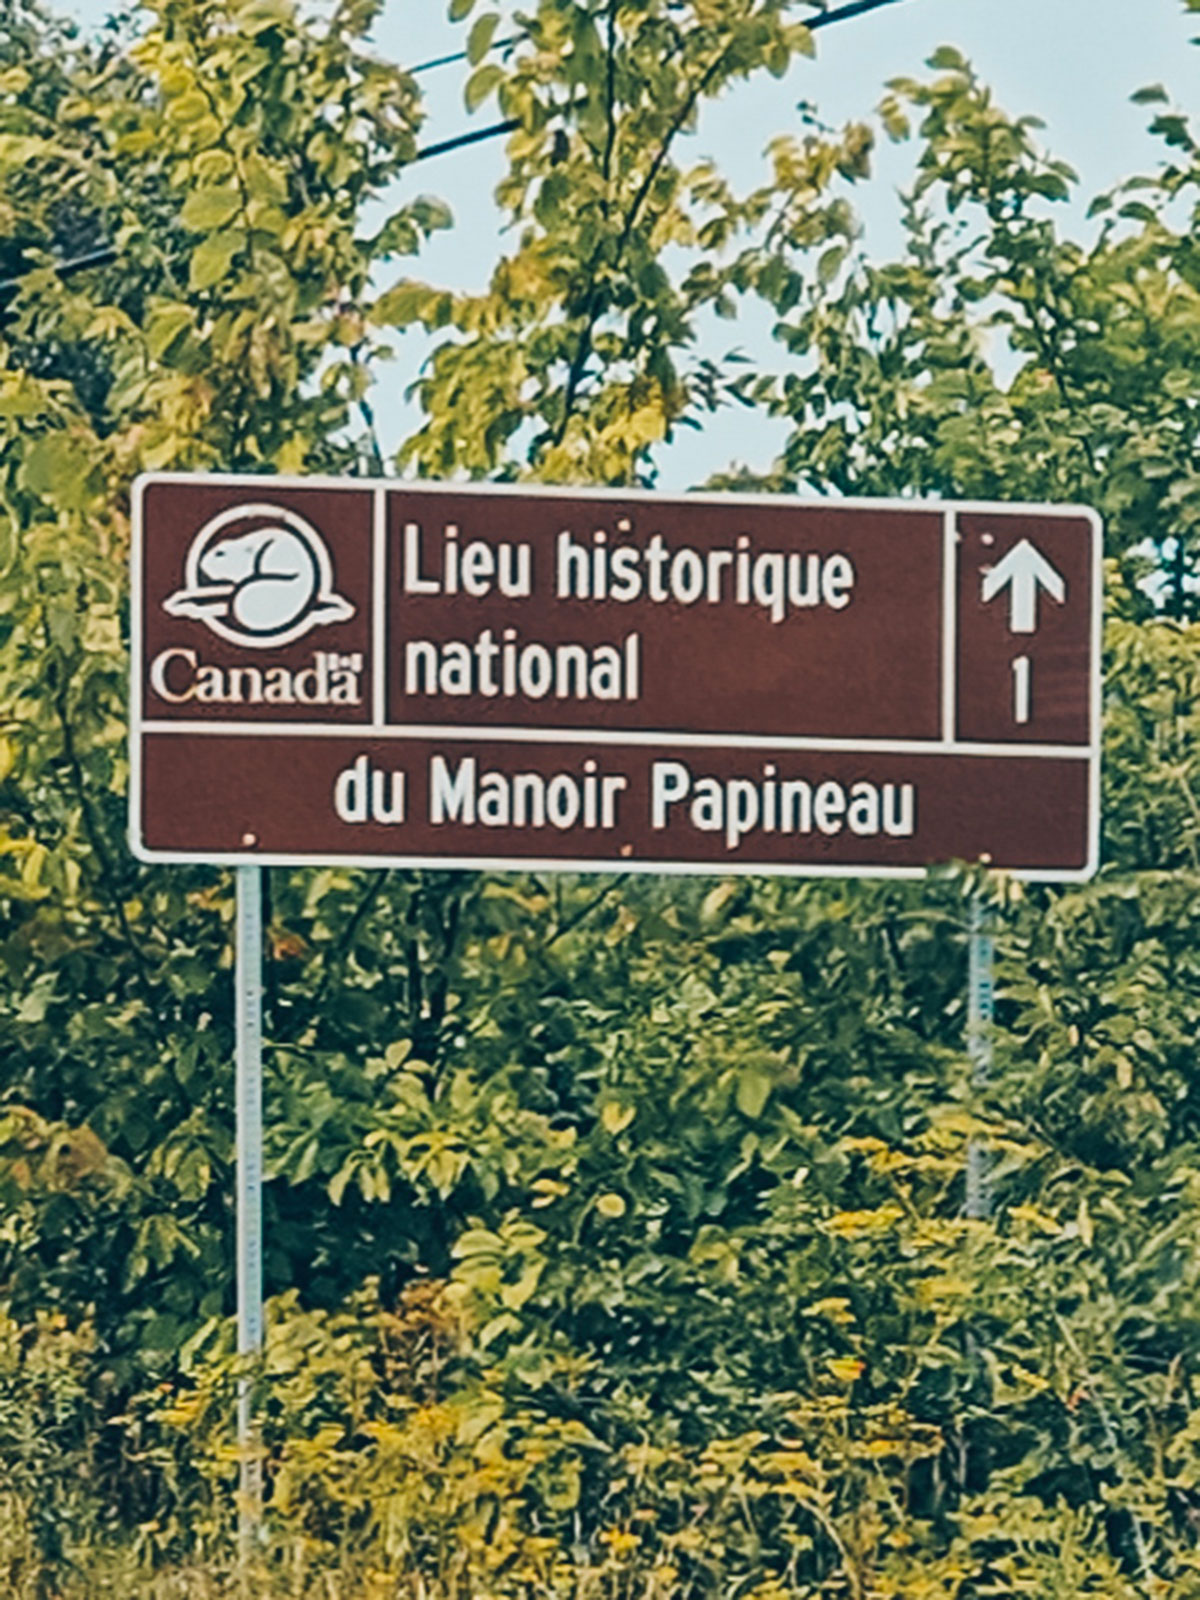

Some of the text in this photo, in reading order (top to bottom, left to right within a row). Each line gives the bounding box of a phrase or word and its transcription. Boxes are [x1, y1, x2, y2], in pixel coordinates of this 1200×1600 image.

[404, 524, 854, 623] Lieu historique
[150, 647, 363, 705] Canada
[405, 629, 638, 700] national
[1012, 656, 1029, 723] 1
[335, 755, 913, 849] du Manoir Papineau
